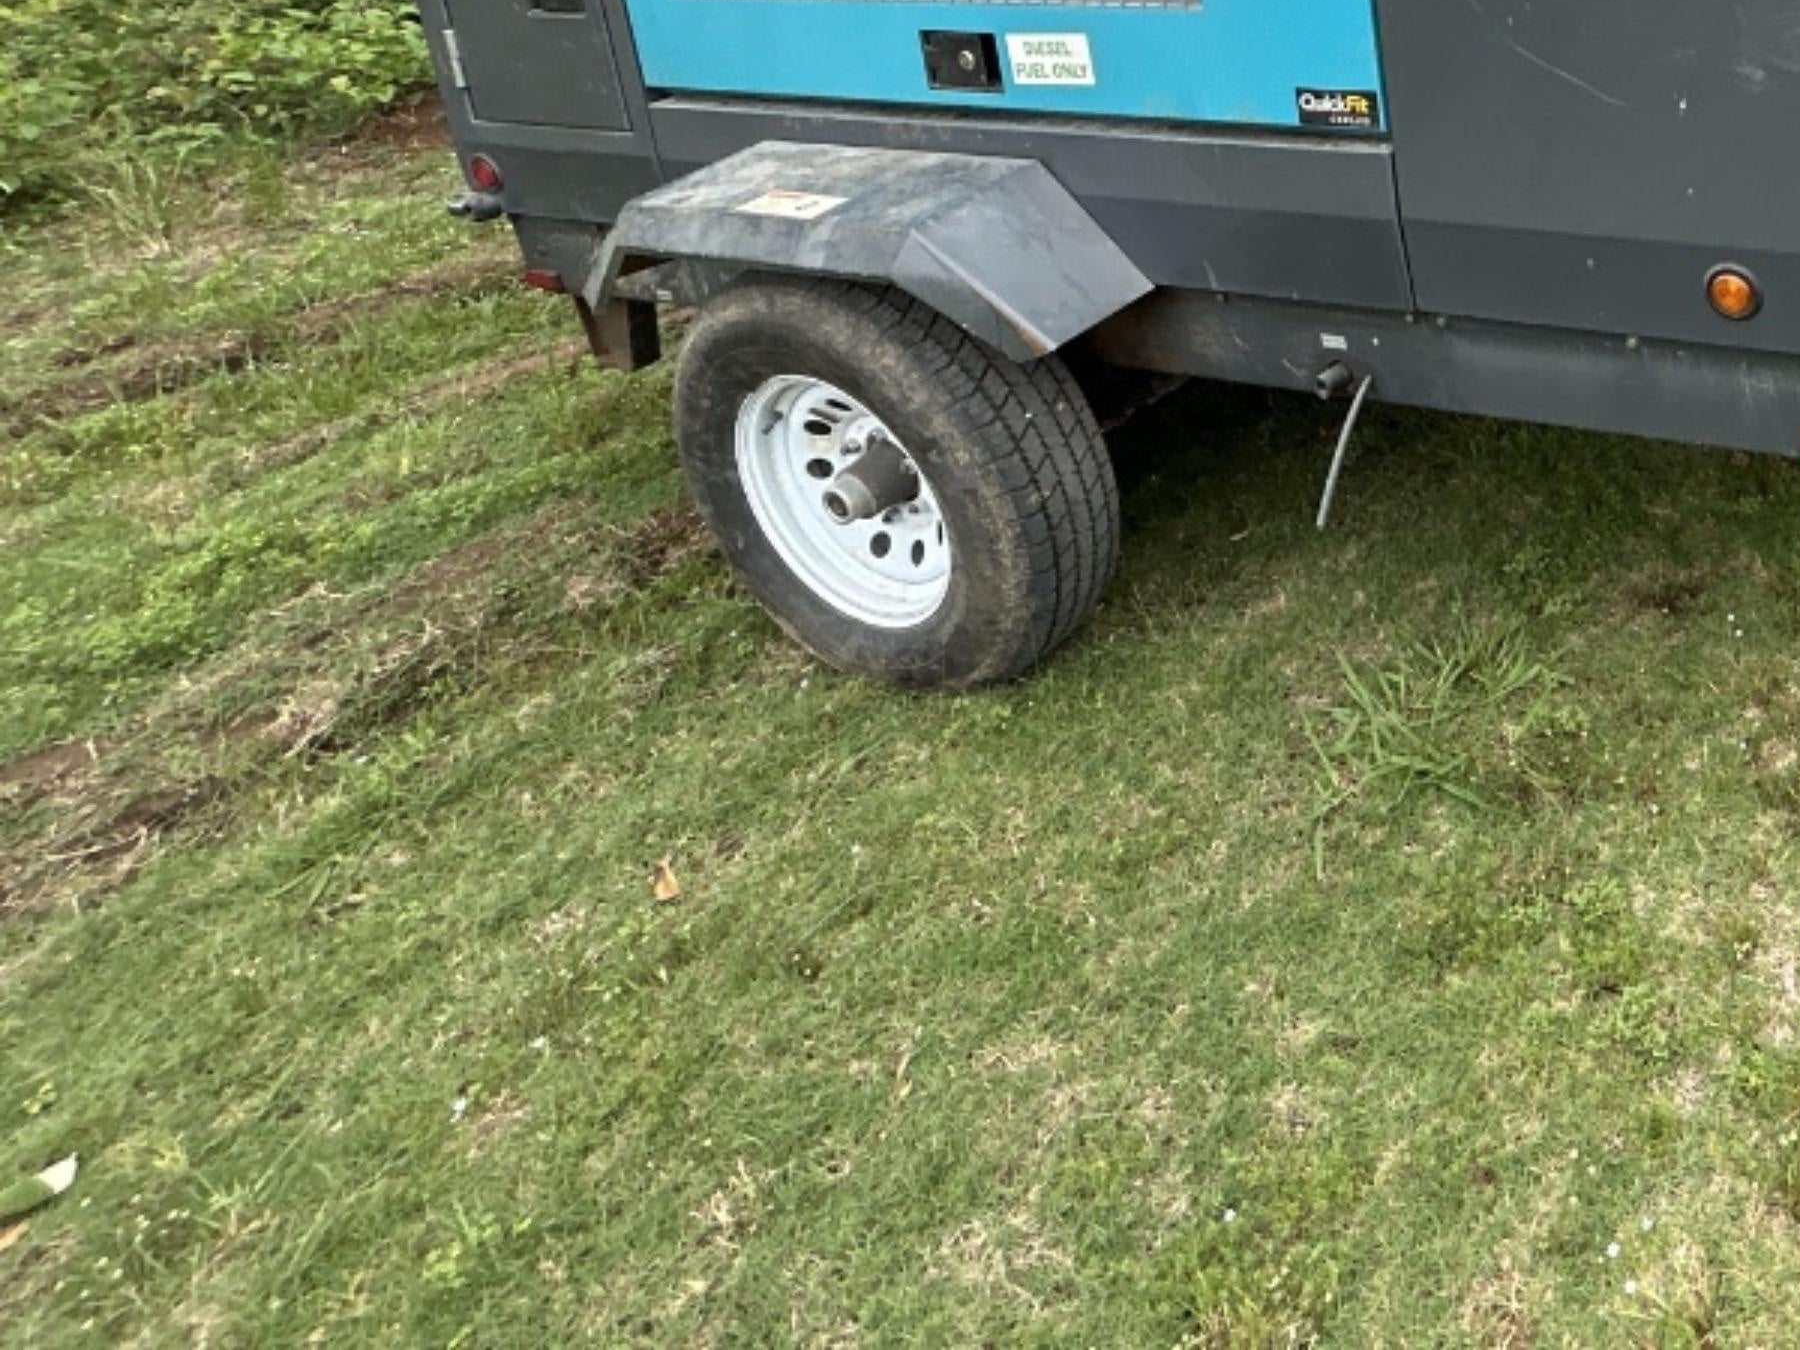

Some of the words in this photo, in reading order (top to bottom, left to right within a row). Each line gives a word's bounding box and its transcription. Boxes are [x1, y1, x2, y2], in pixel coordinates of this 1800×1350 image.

[1022, 41, 1072, 58] DIESEL
[1015, 62, 1049, 79] FUEL
[1052, 62, 1088, 79] ONLY
